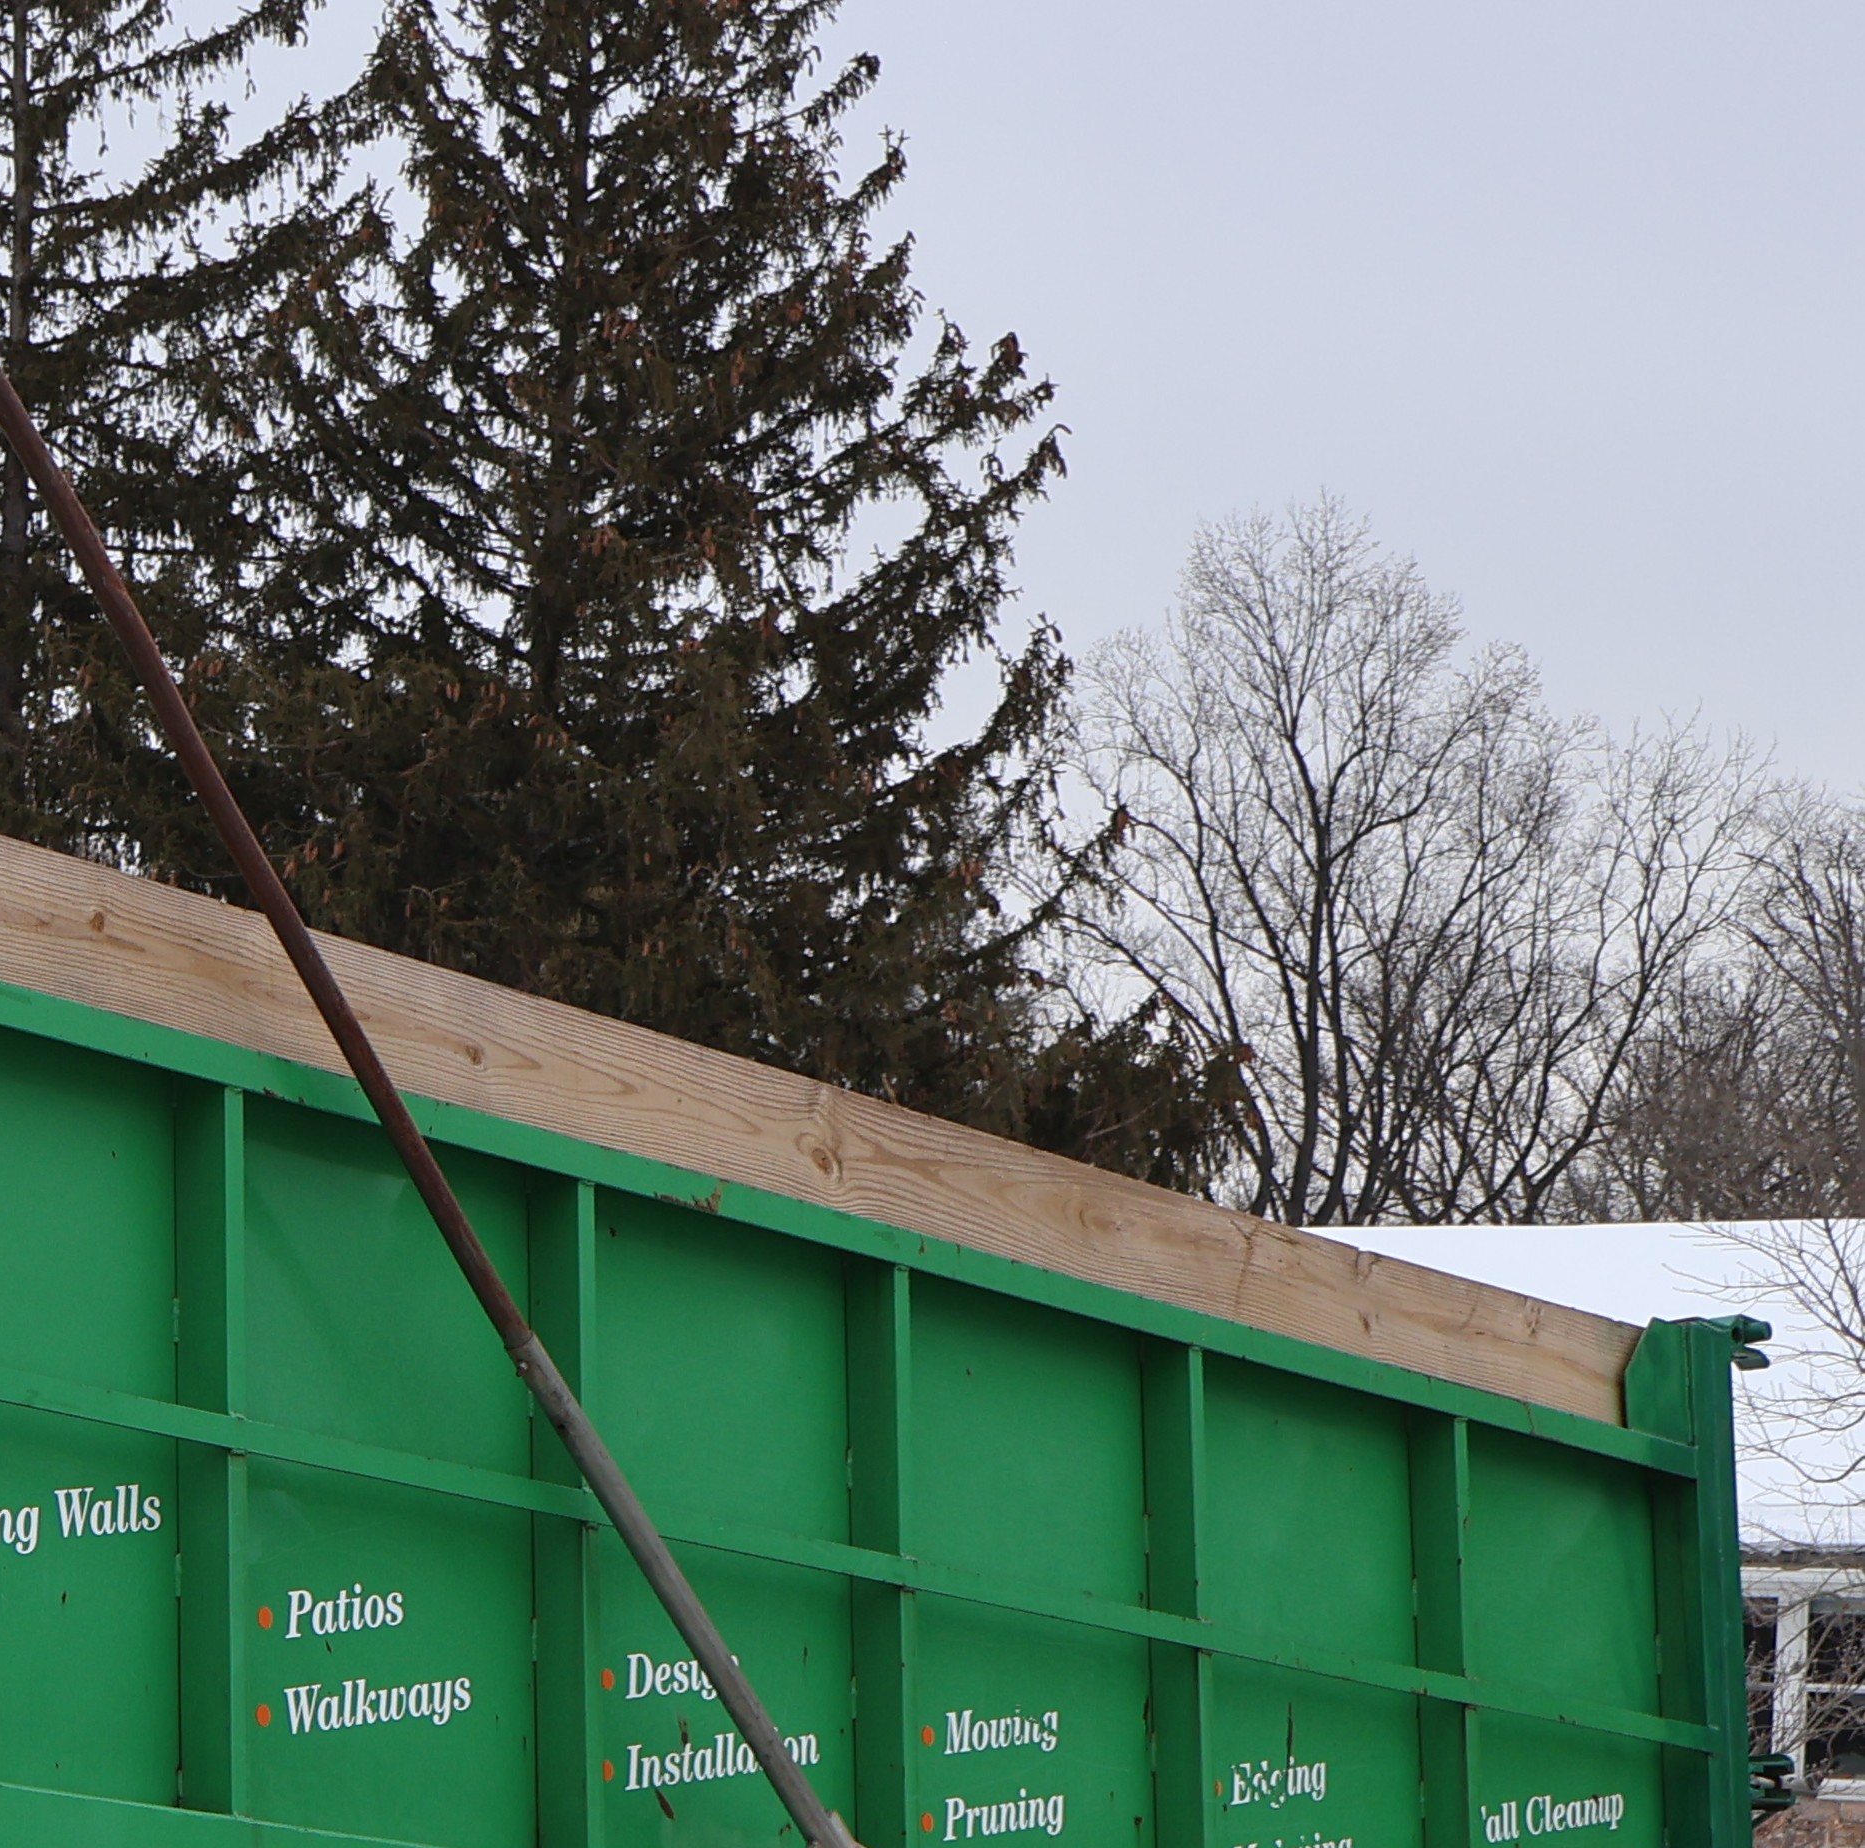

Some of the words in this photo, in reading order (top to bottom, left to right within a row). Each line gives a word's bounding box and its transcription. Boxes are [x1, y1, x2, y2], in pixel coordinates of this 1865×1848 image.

[54, 1484, 162, 1538] Walls
[284, 1583, 405, 1640] Patios
[283, 1676, 471, 1736] Walkways
[944, 1705, 1059, 1755] Mowing
[624, 1728, 820, 1791] Installaon
[943, 1788, 1065, 1842] Pruning
[1480, 1800, 1520, 1843] all
[1525, 1793, 1625, 1836] Cleanup
